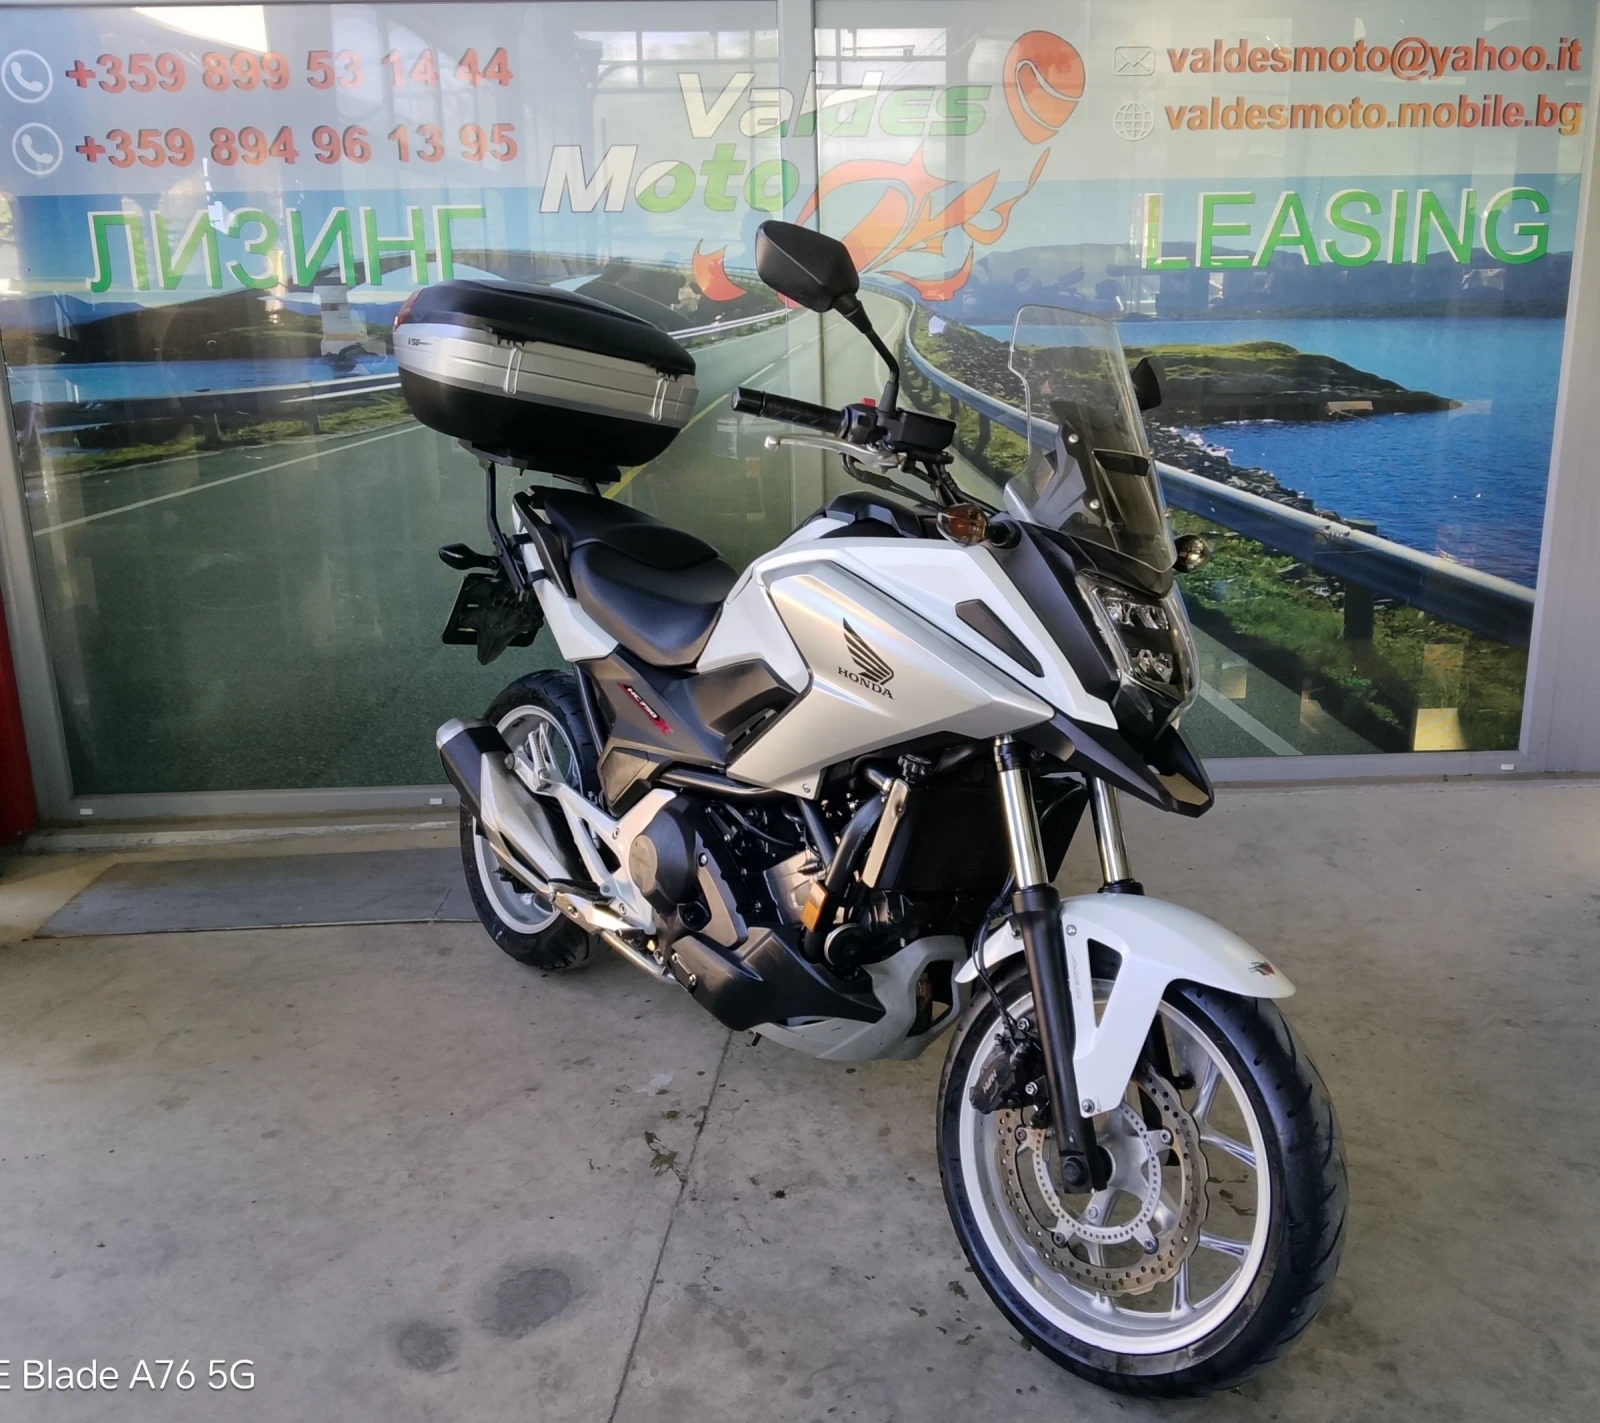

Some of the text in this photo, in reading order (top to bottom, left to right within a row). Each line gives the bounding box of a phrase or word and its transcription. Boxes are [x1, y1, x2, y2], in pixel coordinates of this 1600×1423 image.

[65, 46, 514, 94] +359 899 53 14 44
[1167, 36, 1583, 81] valdesmoto@yahoo.it
[677, 70, 991, 139] Valdes
[1164, 93, 1584, 136] valdesmoto.mobile.bg
[75, 122, 519, 169] +359 894 96 13 95
[538, 143, 800, 214] Moto
[85, 204, 488, 293] ЛИЗИНГ
[1140, 187, 1551, 270] LEASING
[837, 666, 895, 700] HONDA
